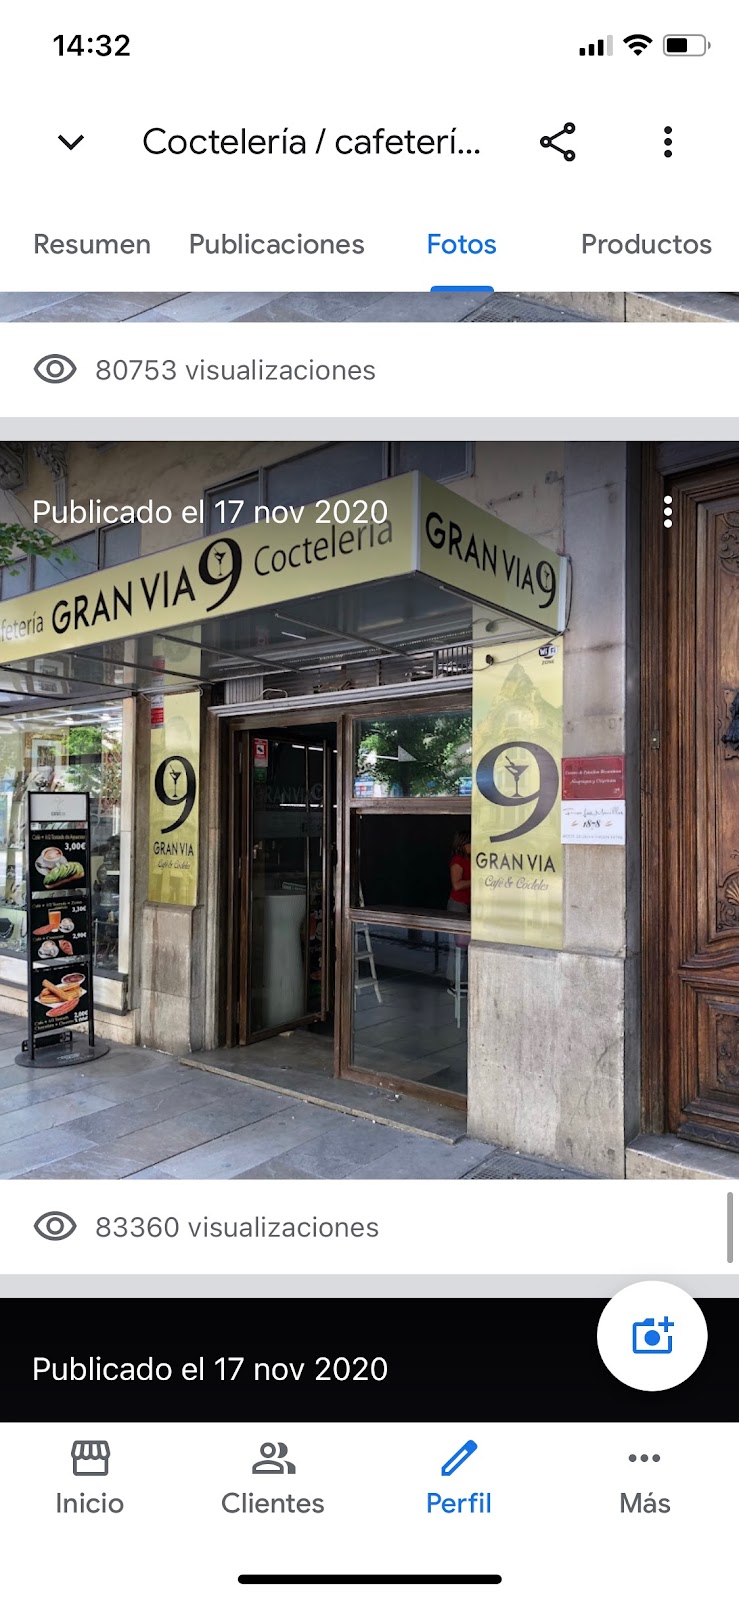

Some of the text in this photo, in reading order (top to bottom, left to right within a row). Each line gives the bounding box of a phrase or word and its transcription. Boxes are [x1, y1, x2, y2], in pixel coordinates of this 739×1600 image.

[53, 34, 131, 57] 14:32
[142, 126, 306, 155] Coctelería
[315, 127, 327, 155] /
[34, 233, 151, 255] Resumen
[190, 232, 365, 255] Publicaciones
[427, 233, 497, 255] Fotos
[582, 233, 713, 255] Productos
[95, 358, 376, 381] 80753 visualizaciones
[425, 511, 557, 609] GRAN VIA 9
[52, 581, 132, 634] GRAN
[140, 564, 196, 613] VIA
[199, 538, 242, 613] 9
[154, 755, 197, 834] 9
[476, 740, 559, 844] 9
[64, 842, 87, 852] 3,00€
[153, 841, 194, 857] GRAN VIA
[475, 852, 556, 873] GRAN VIA
[484, 874, 504, 890] Café
[503, 876, 513, 888] &
[95, 1215, 379, 1238] 83360 visualizaciones
[33, 1356, 388, 1381] Publicado el 17 nov 2020
[56, 1492, 124, 1514] Inicio
[221, 1491, 325, 1514] Clientes
[427, 1491, 491, 1514] Perfil
[620, 1491, 671, 1514] Más
